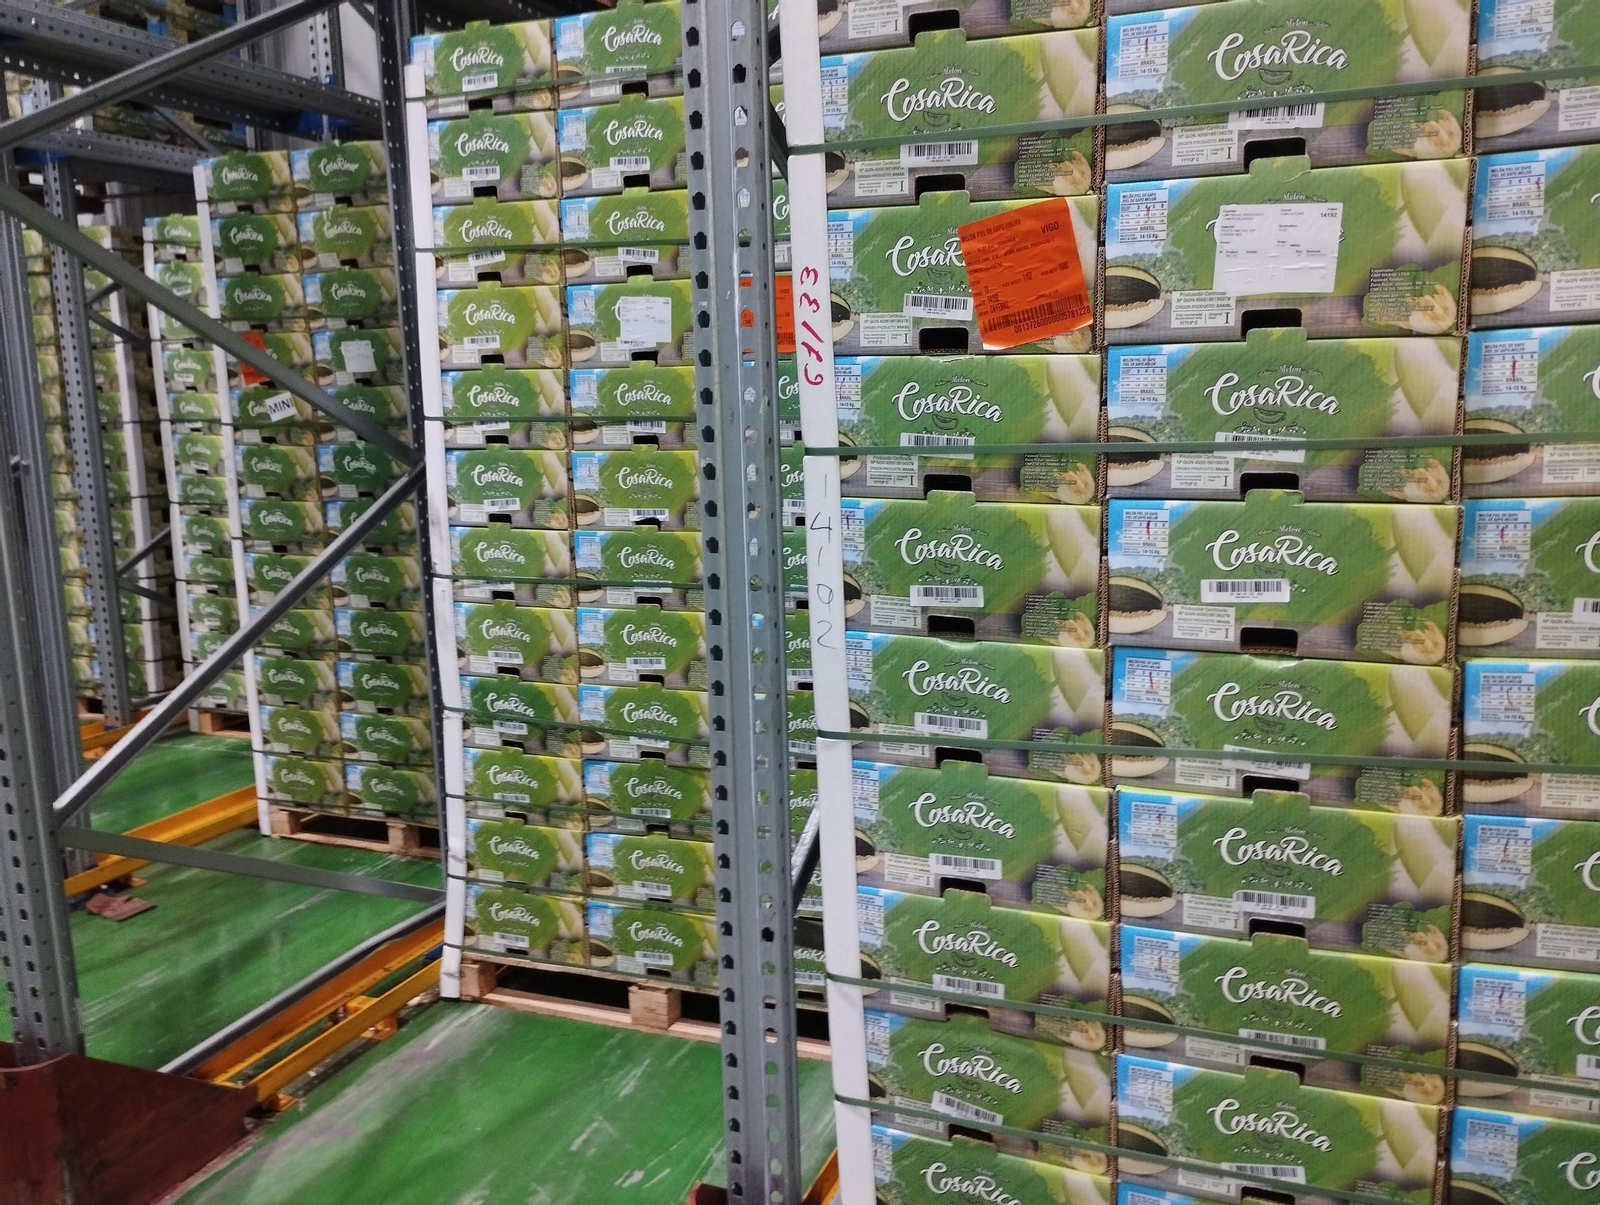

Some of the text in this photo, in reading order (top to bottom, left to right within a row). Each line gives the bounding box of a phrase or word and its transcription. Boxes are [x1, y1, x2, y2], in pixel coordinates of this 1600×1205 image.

[1207, 30, 1348, 80] CosaRica
[880, 77, 996, 122] CosaRica
[1040, 221, 1059, 234] VIGO
[268, 396, 294, 416] MINI
[891, 382, 1003, 423] CosaRica
[1203, 372, 1341, 416] CosaRica
[894, 528, 1004, 571] CosaRica
[1205, 530, 1339, 577] CosaRica
[902, 659, 1012, 704] CosaRica
[1206, 683, 1338, 732] CosaRica
[907, 792, 1016, 840] CosaRica
[1213, 827, 1344, 879] CosaRica
[912, 920, 1019, 968] CosaRica
[1214, 966, 1343, 1019] CosaRica
[917, 1043, 1022, 1095] CosaRica
[1207, 1099, 1332, 1152] CosaRica
